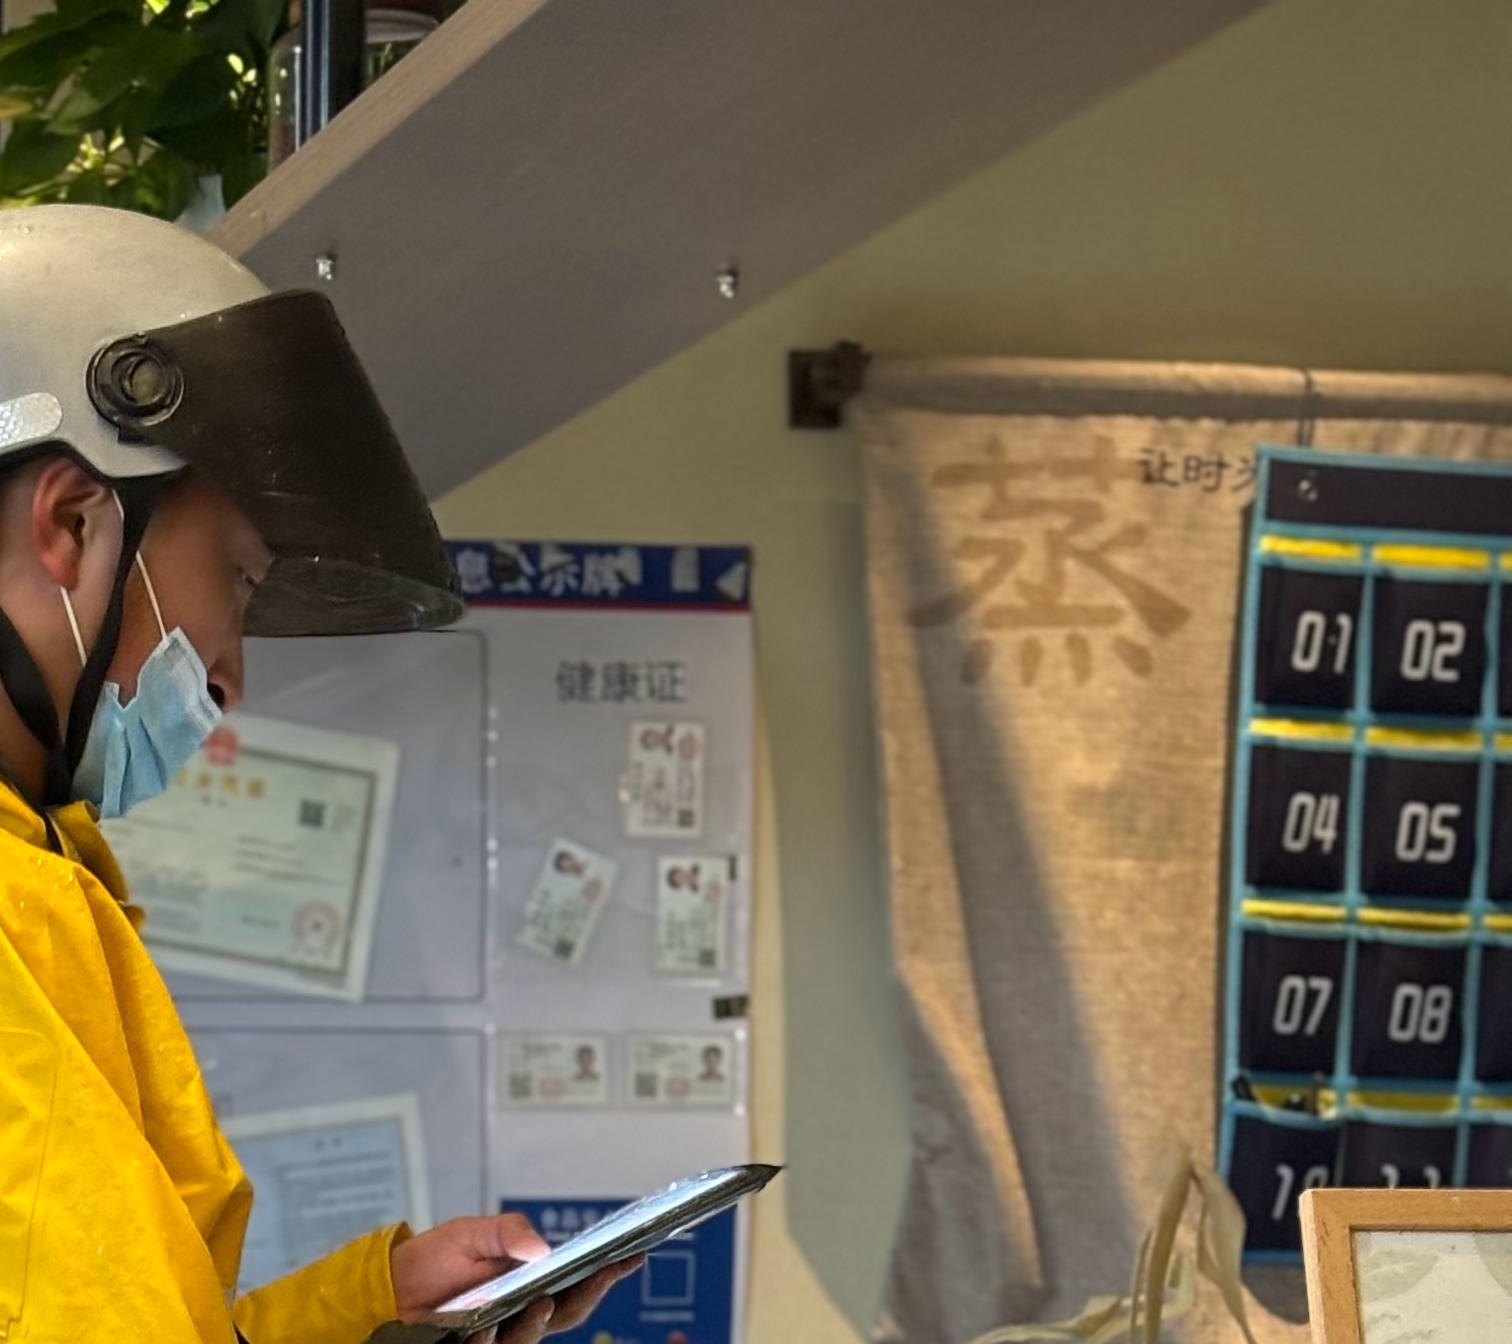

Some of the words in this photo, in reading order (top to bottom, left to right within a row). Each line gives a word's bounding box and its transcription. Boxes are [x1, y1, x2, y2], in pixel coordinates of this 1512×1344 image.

[1291, 610, 1353, 673] 01
[1400, 619, 1466, 683] 02
[555, 659, 687, 704] 健康证
[1282, 791, 1340, 854] 04
[1395, 801, 1462, 864] 05
[1273, 974, 1334, 1036] 07
[1389, 983, 1454, 1043] 08
